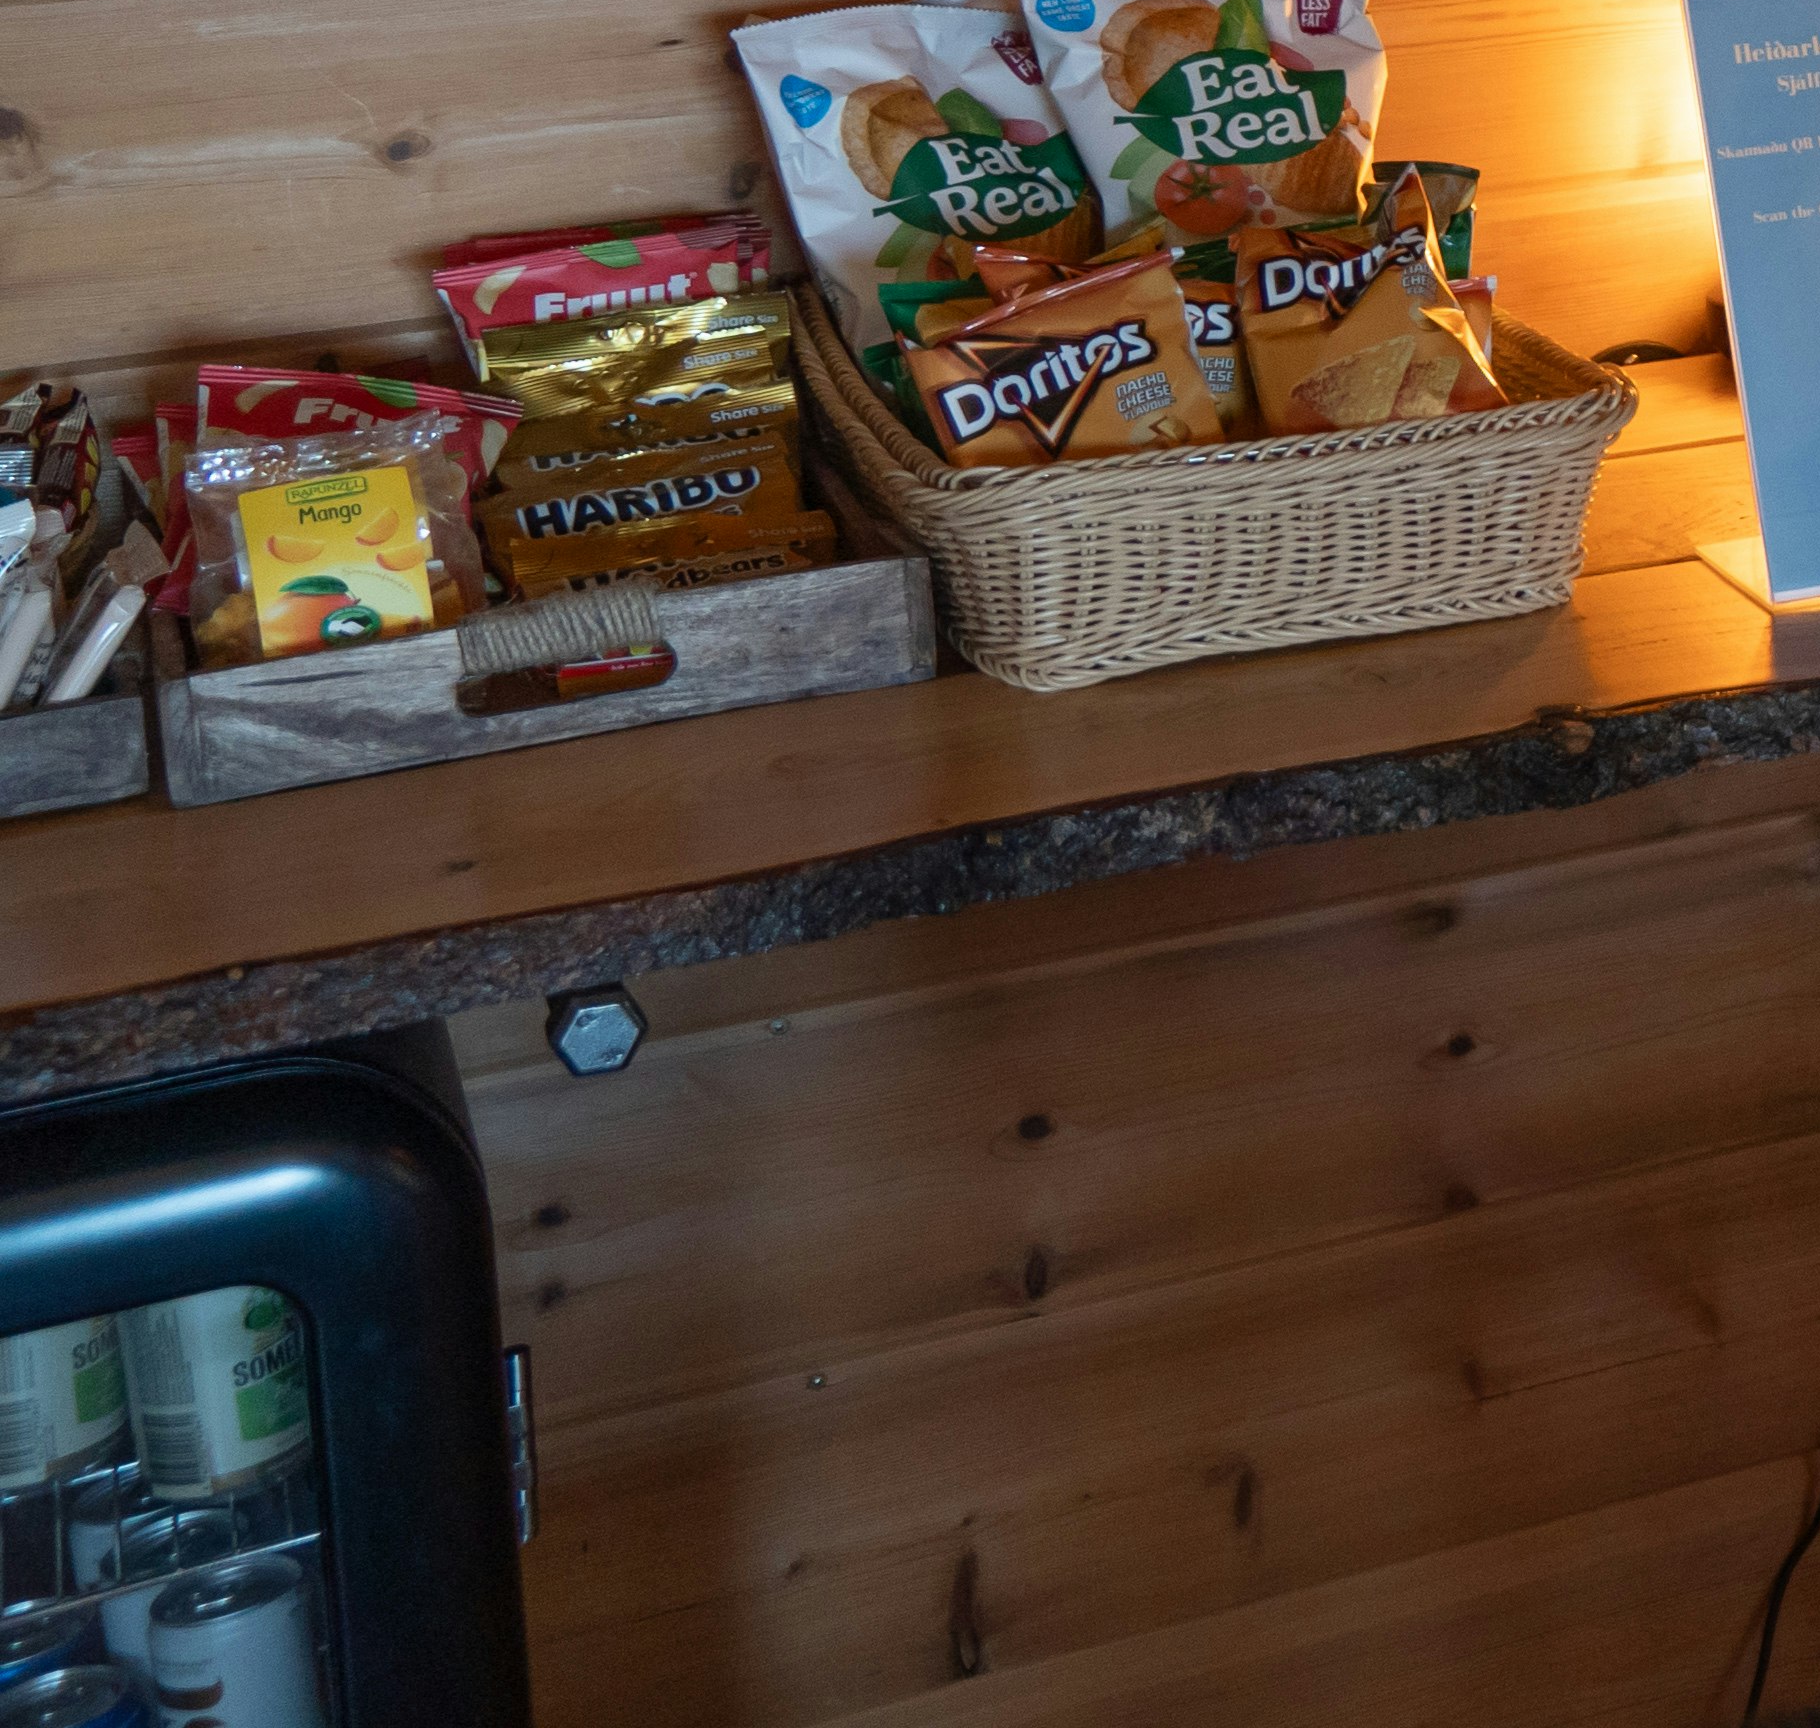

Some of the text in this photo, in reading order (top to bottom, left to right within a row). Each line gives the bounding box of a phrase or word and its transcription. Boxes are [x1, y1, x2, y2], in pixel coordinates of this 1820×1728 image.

[1180, 56, 1299, 111] Eat
[1172, 90, 1328, 161] Real
[1791, 136, 1814, 153] QR
[929, 137, 1037, 186] Eat
[930, 167, 1078, 235] Real
[1753, 210, 1788, 223] Scan
[709, 313, 755, 330] Share
[683, 348, 759, 370] Share Size
[943, 323, 1156, 438] Doritos
[1116, 372, 1166, 397] NACHO
[1116, 383, 1172, 413] CHEESE
[710, 402, 786, 423] Share Size
[289, 479, 363, 501] RAPUNZEL
[298, 502, 363, 525] Mango
[517, 466, 762, 540] HARIBO
